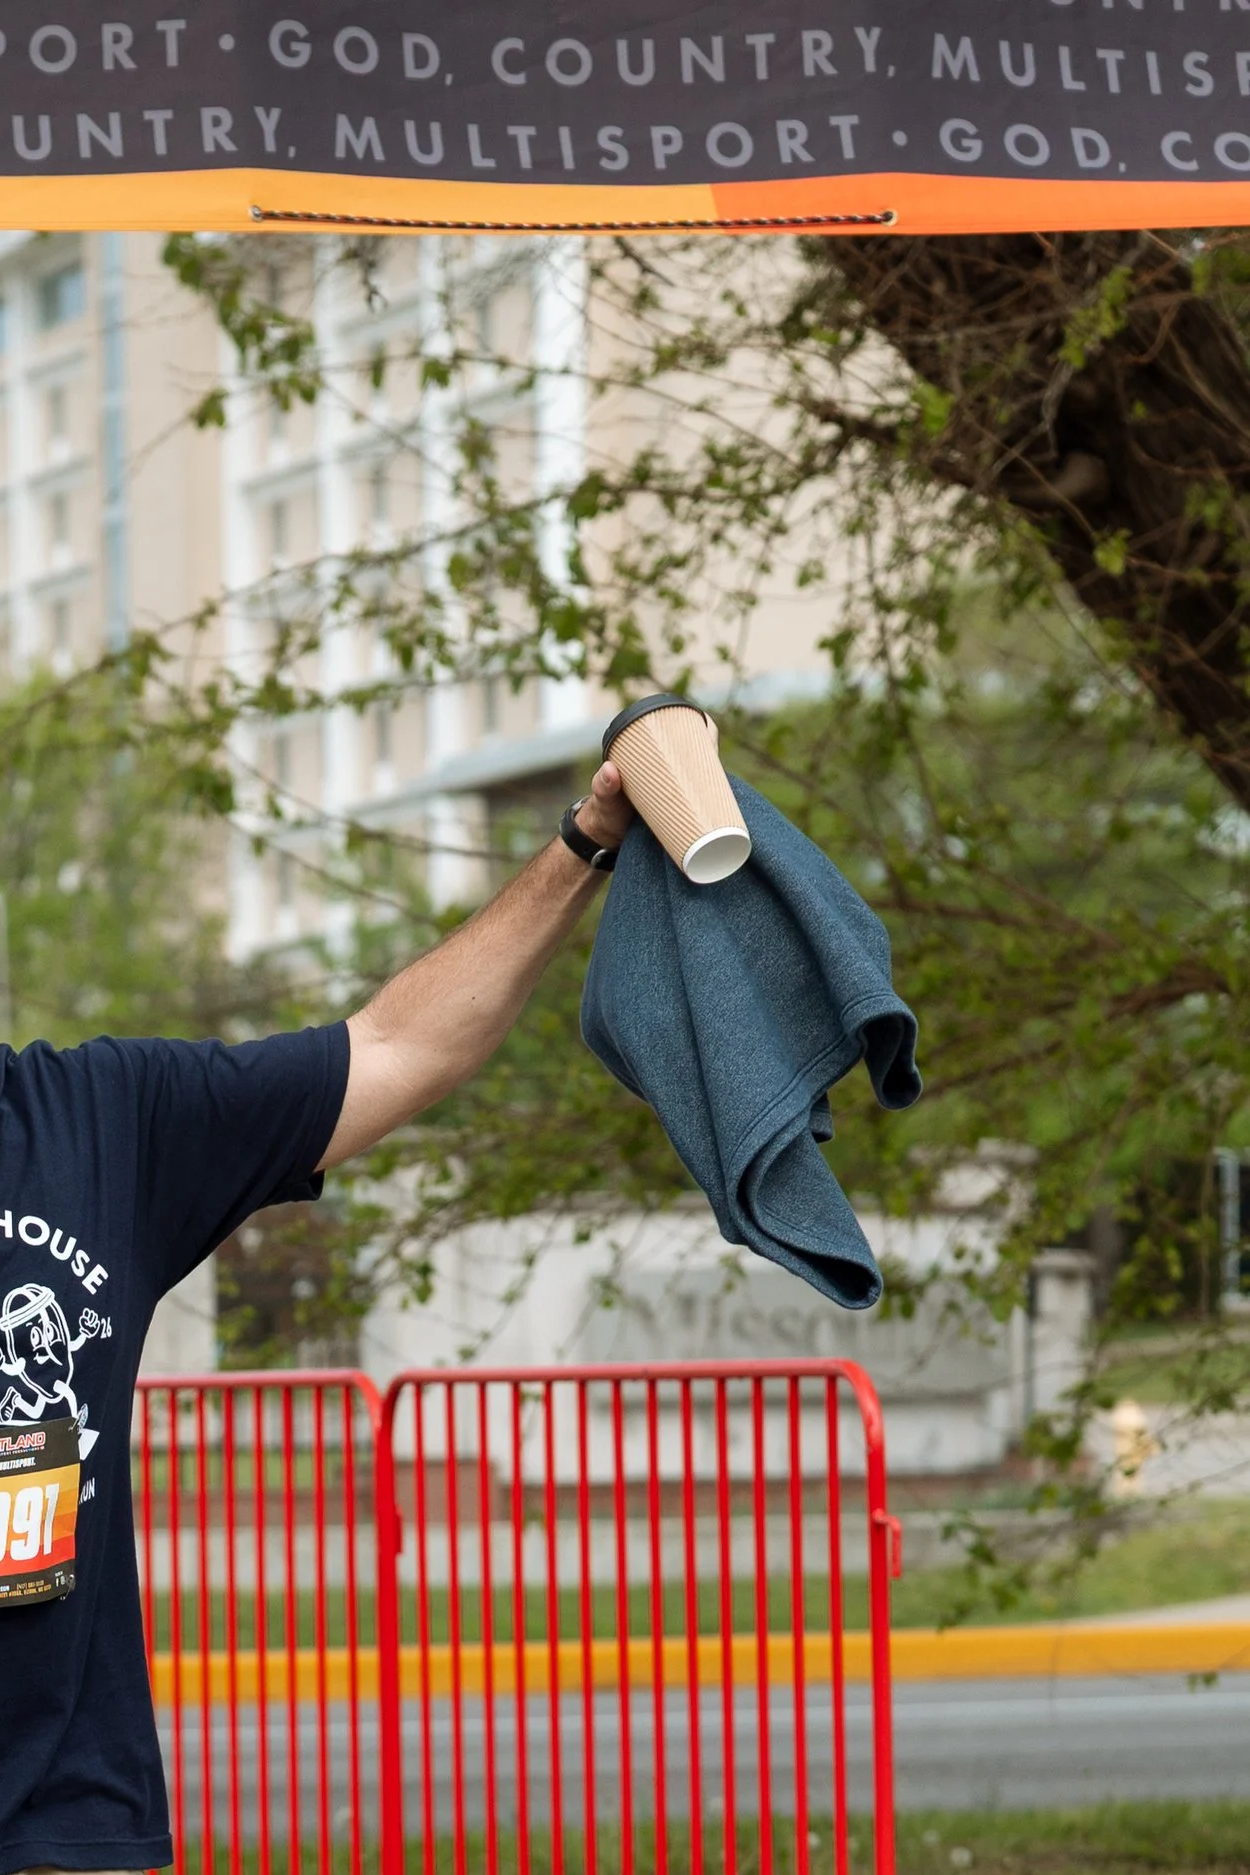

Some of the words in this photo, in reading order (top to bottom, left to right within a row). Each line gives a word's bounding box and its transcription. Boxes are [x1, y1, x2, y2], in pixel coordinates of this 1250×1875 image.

[269, 19, 454, 86] GOD,
[490, 26, 898, 86] COUNTRY,
[336, 114, 860, 171] MULTISPORT
[940, 118, 1128, 173] GOD,
[100, 1317, 112, 1339] 26
